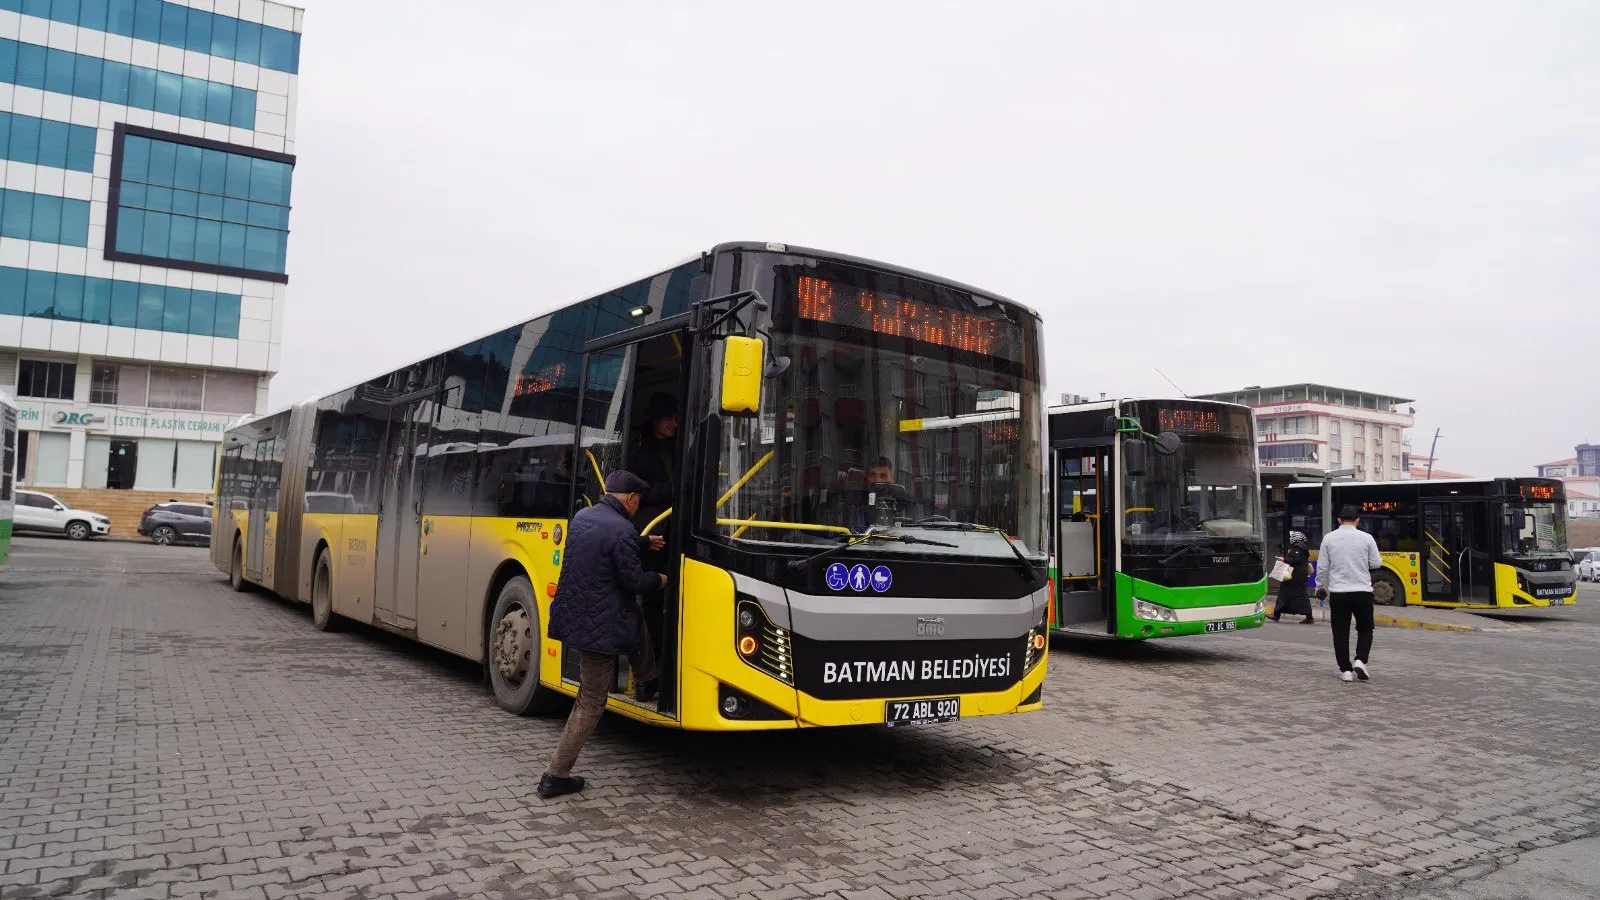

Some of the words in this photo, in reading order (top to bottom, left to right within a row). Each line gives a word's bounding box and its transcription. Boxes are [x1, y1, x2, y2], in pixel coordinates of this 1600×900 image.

[113, 416, 147, 428] ESTETİK
[151, 417, 186, 430] PLASTİK
[188, 420, 220, 432] CERRAHİ
[823, 660, 915, 683] BATMAN
[921, 653, 1011, 680] BELEDİYESİ
[894, 703, 910, 720] 72
[912, 702, 935, 719] ABL
[937, 700, 958, 717] 920
